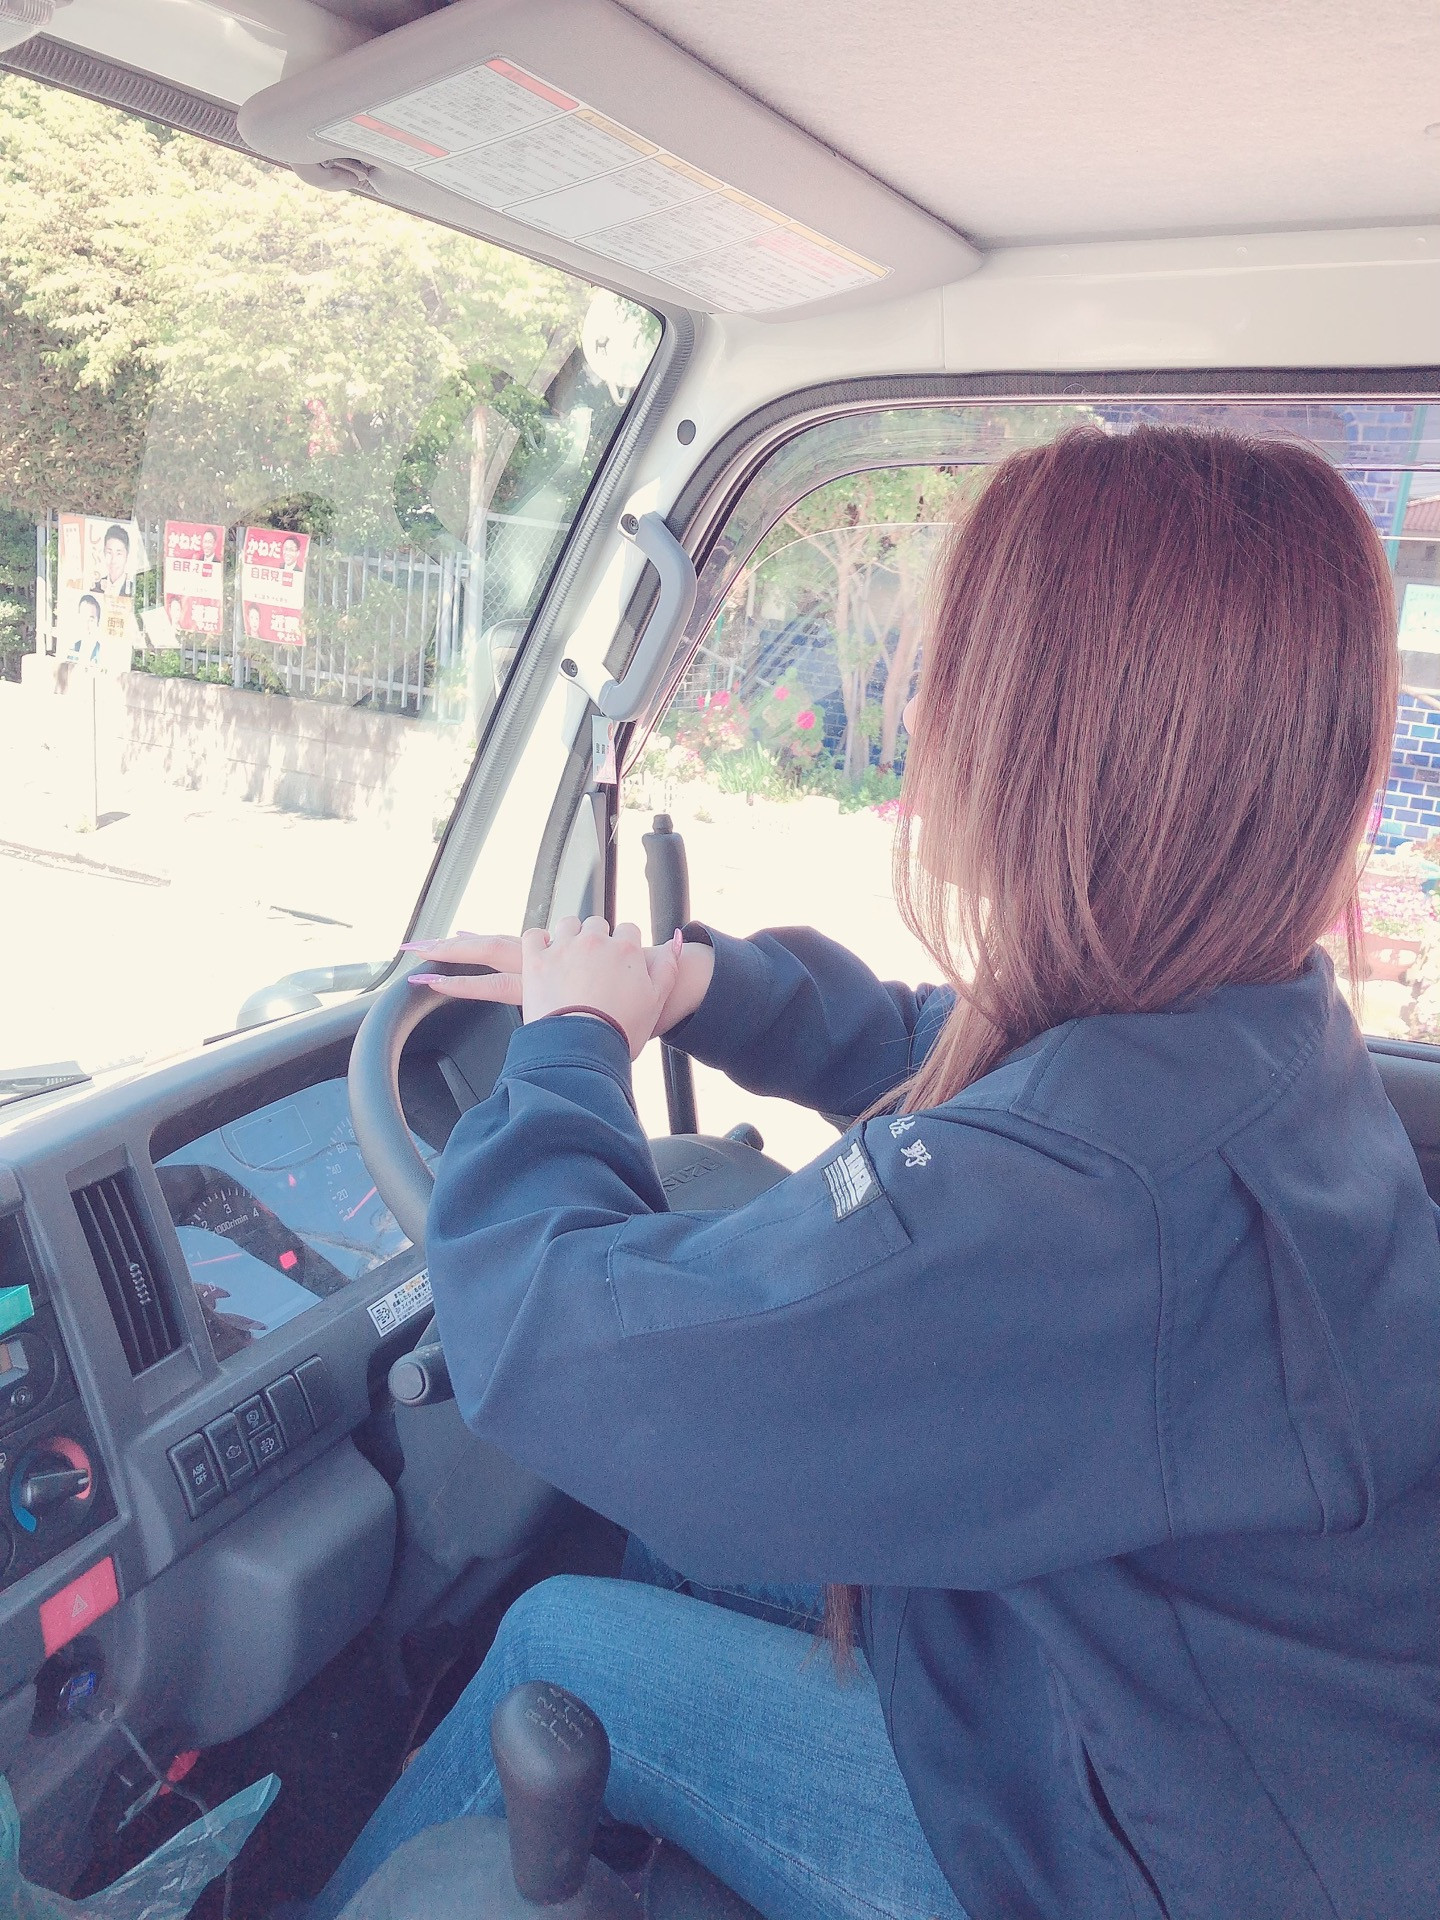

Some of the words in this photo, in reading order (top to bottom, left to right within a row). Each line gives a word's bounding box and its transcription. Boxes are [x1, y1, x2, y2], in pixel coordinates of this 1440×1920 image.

[168, 532, 202, 551] かねだ
[246, 538, 282, 559] かねだ
[251, 567, 280, 583] 自民党
[331, 1163, 342, 1175] 40
[336, 1189, 349, 1201] 20
[223, 1203, 232, 1214] 3
[252, 1207, 260, 1218] 4
[192, 1463, 205, 1478] ASR
[195, 1471, 207, 1486] OFF
